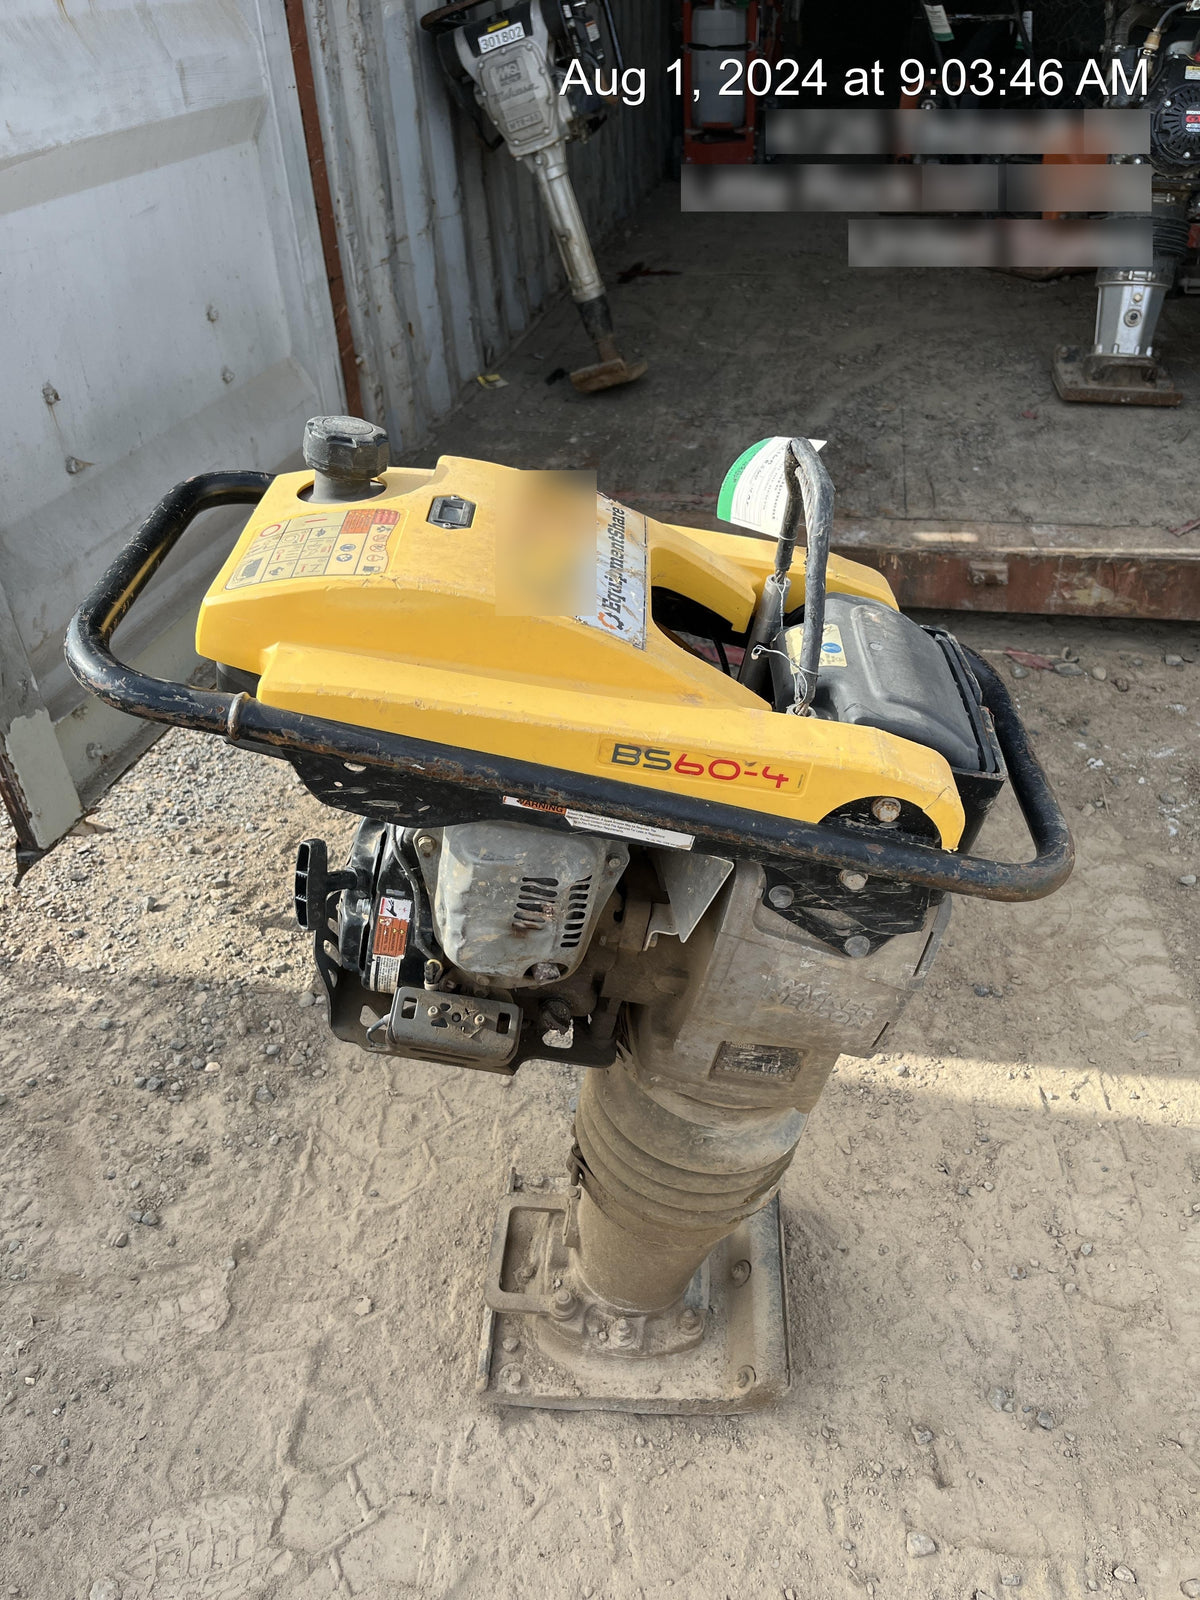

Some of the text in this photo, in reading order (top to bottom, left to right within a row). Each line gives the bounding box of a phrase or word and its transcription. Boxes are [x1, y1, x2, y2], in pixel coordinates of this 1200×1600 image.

[481, 26, 523, 50] 301802
[601, 506, 627, 614] EquipmentShare
[611, 743, 789, 788] BS60-4
